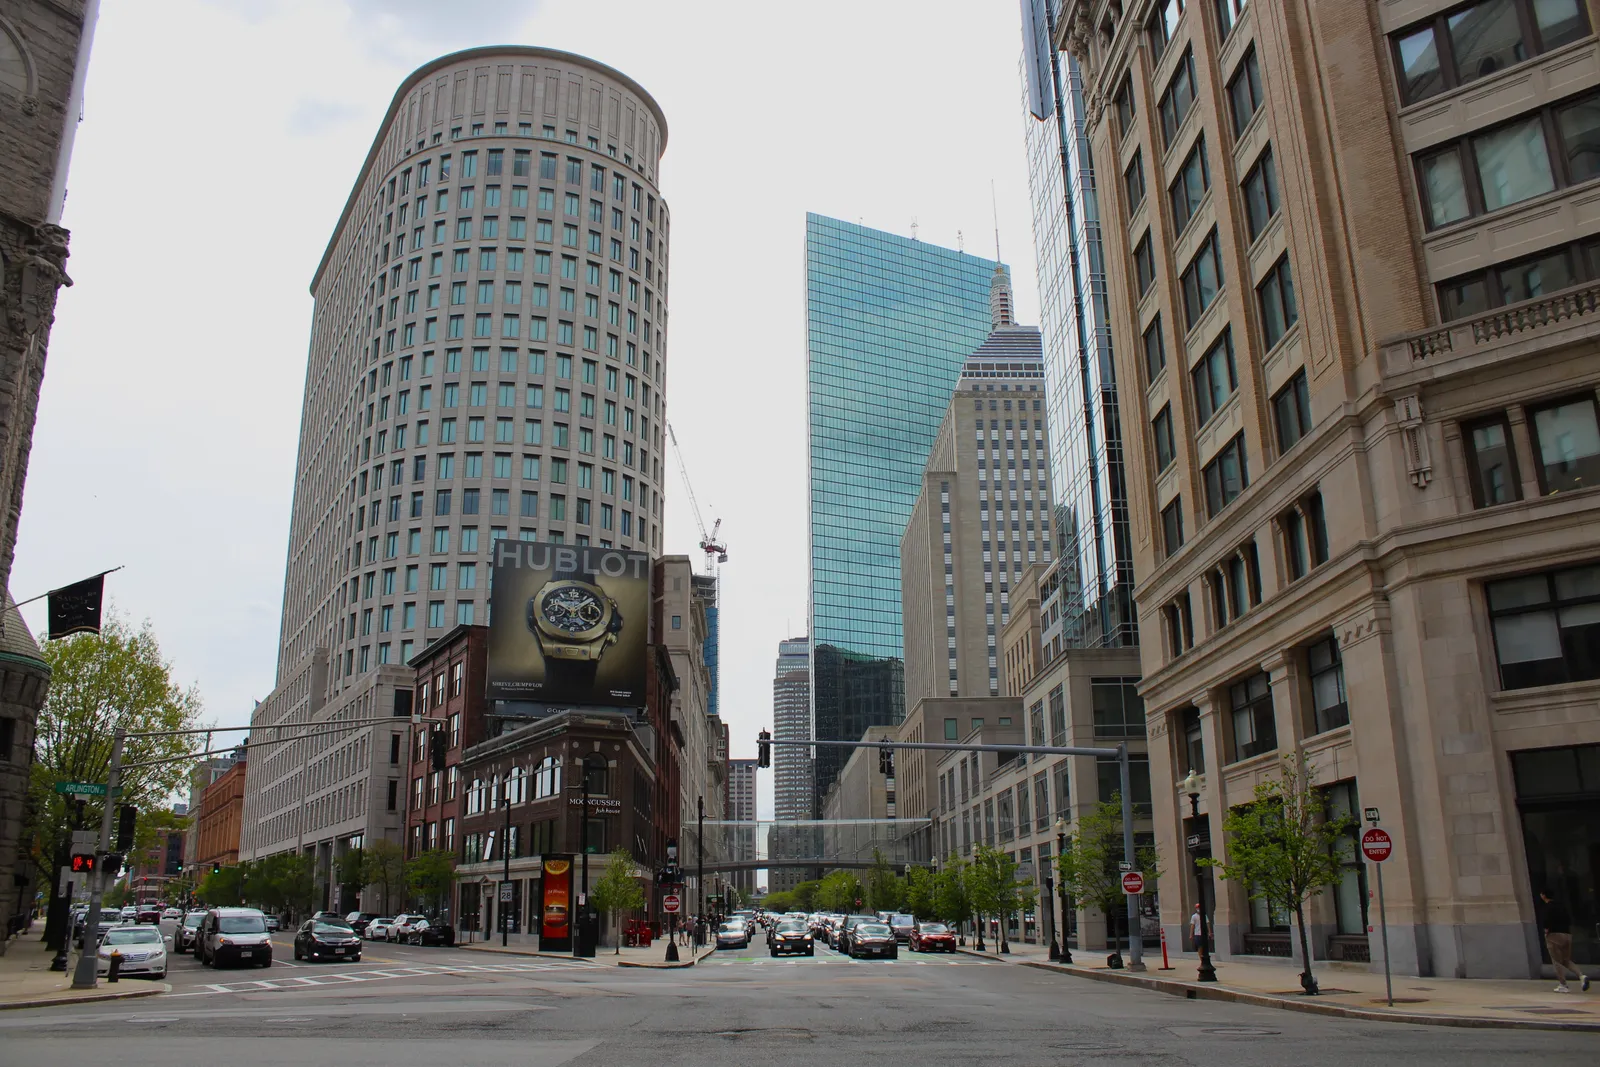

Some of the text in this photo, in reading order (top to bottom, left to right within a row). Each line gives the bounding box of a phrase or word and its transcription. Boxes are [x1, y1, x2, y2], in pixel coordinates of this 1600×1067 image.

[498, 543, 648, 579] HUBLOT
[65, 784, 100, 794] ARLINGTON
[87, 859, 93, 869] 4
[501, 892, 512, 900] 28
